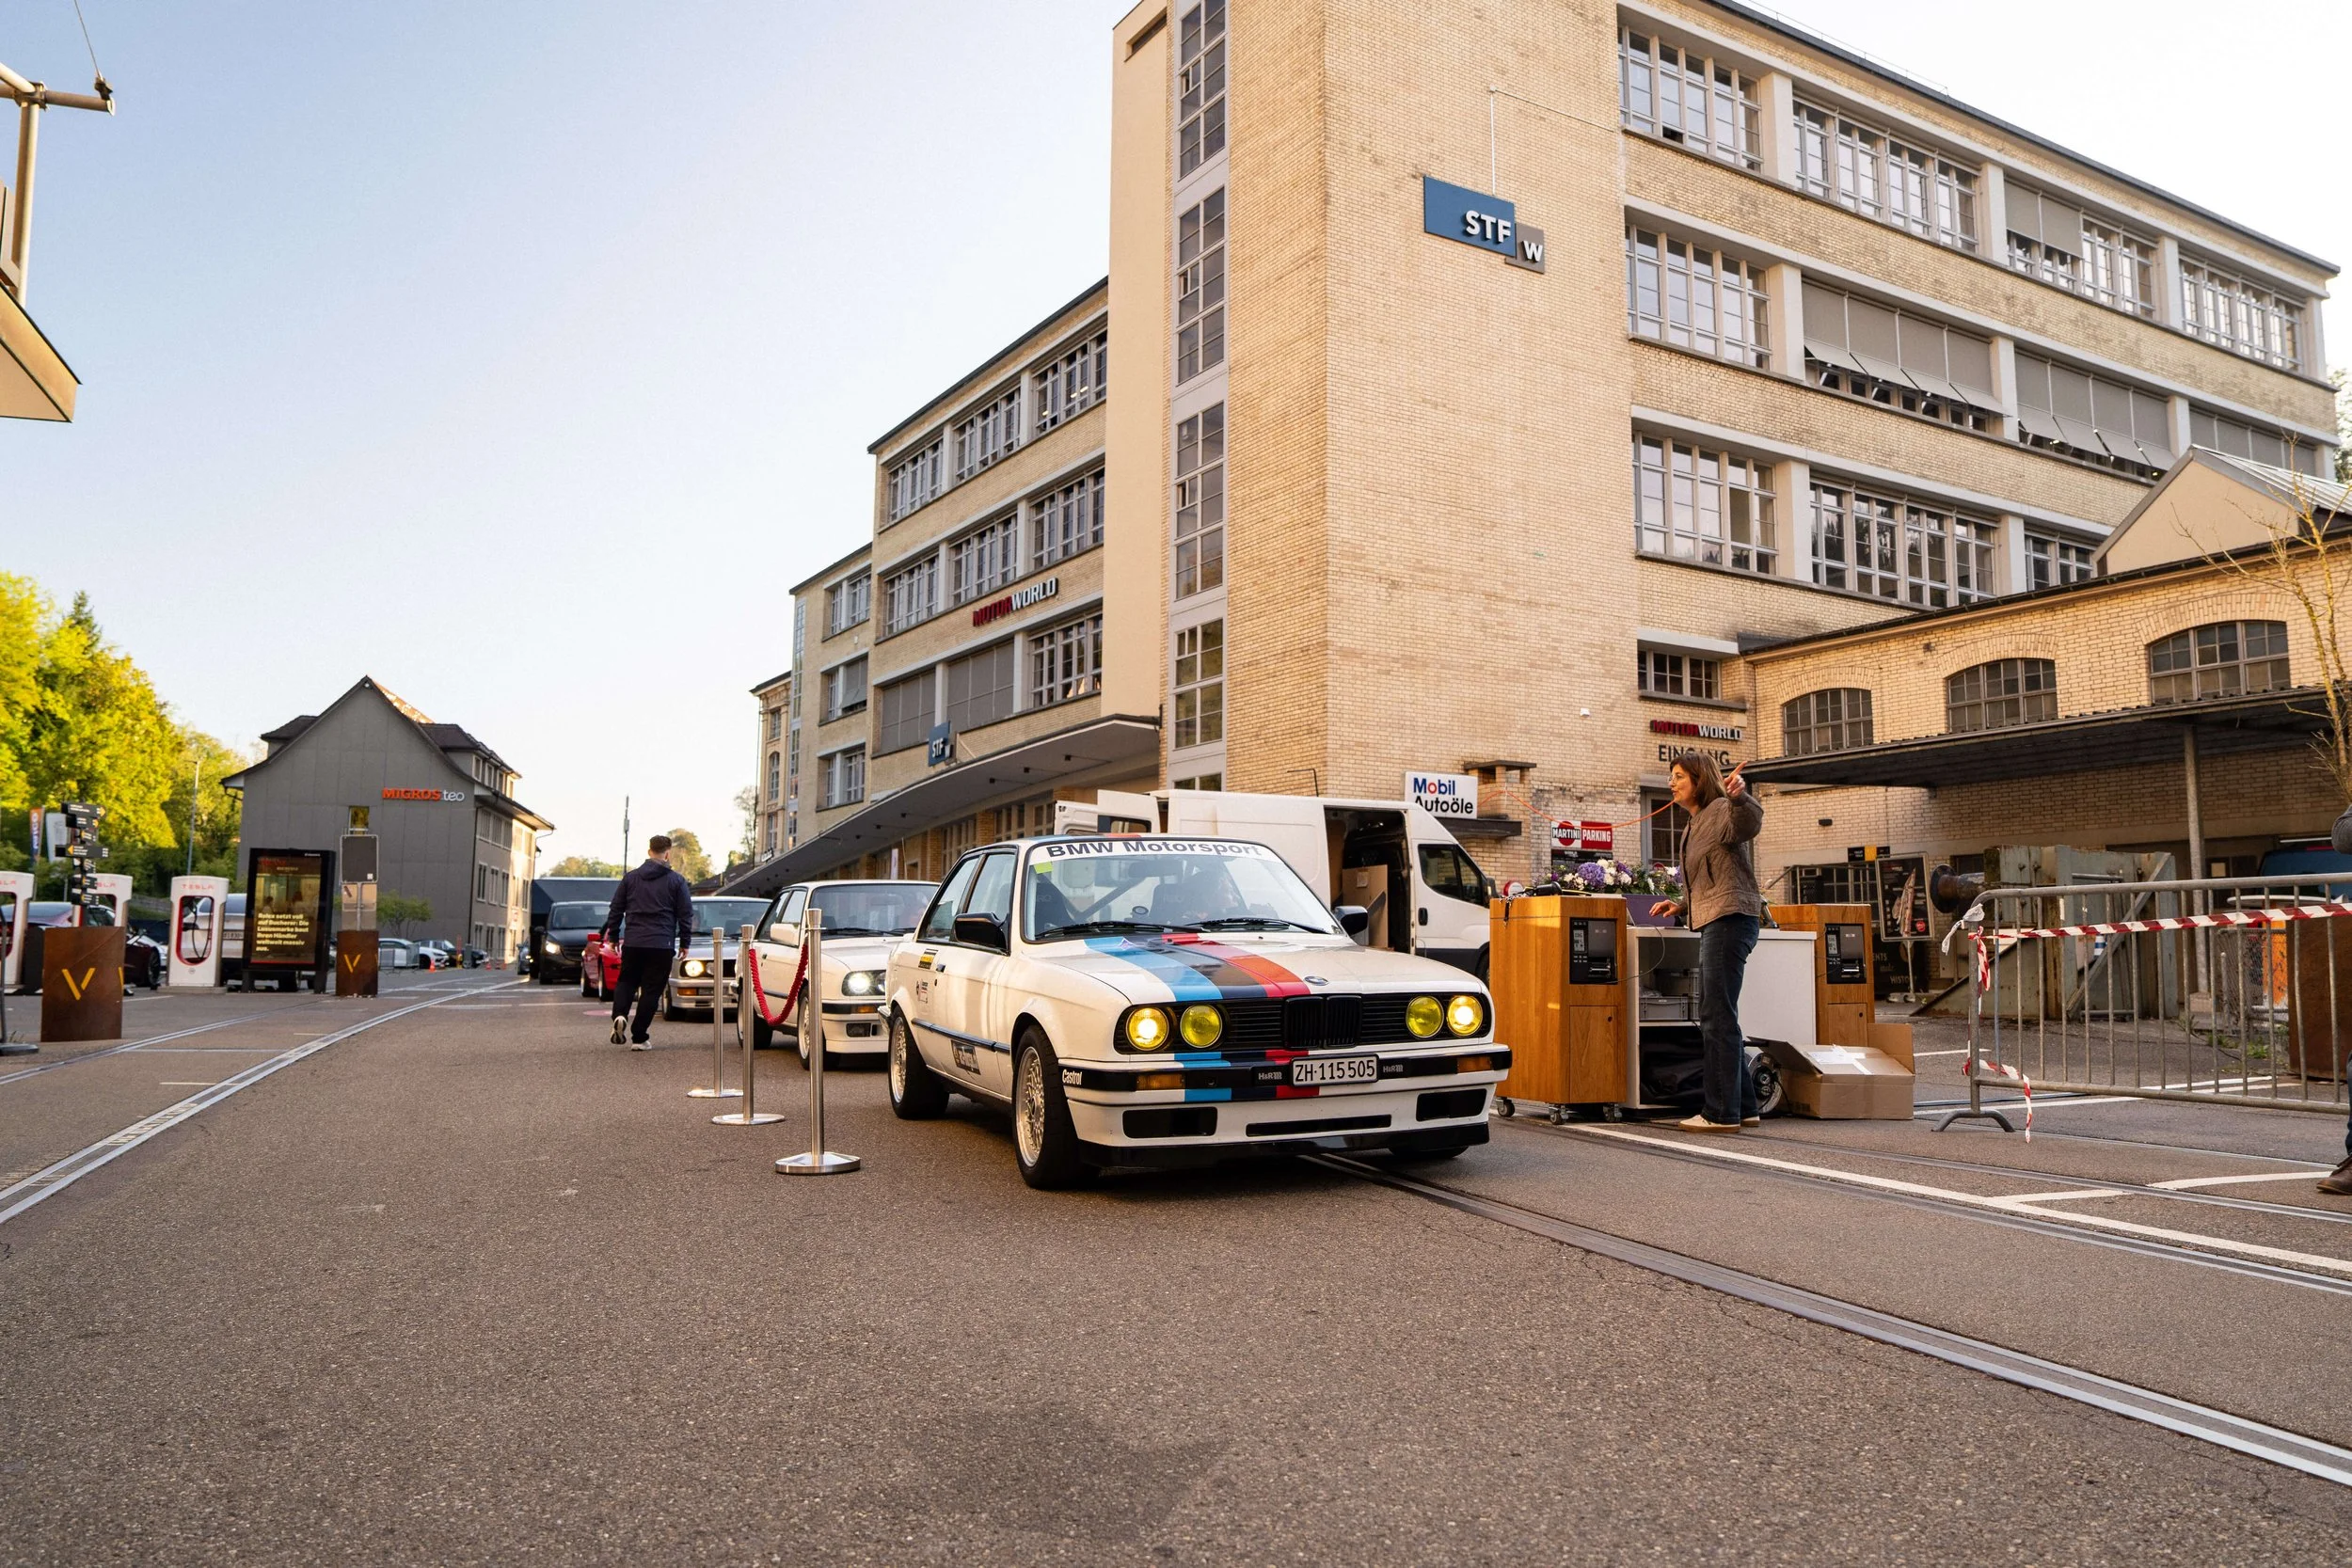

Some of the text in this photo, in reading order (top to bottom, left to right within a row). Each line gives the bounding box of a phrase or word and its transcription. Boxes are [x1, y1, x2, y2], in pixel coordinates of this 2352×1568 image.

[1466, 210, 1543, 262] STF W
[973, 578, 1057, 627] MOTORWORLD
[1650, 720, 1742, 740] MOTORWORLD
[932, 737, 944, 757] STF
[1659, 745, 1730, 766] EINNG
[382, 787, 466, 801] MIGROS teo
[1413, 777, 1455, 796] Mobil
[1552, 828, 1612, 842] MARTINI PARKING
[1046, 841, 1263, 857] BMW Motorsport
[1062, 1069, 1082, 1085] Castrol
